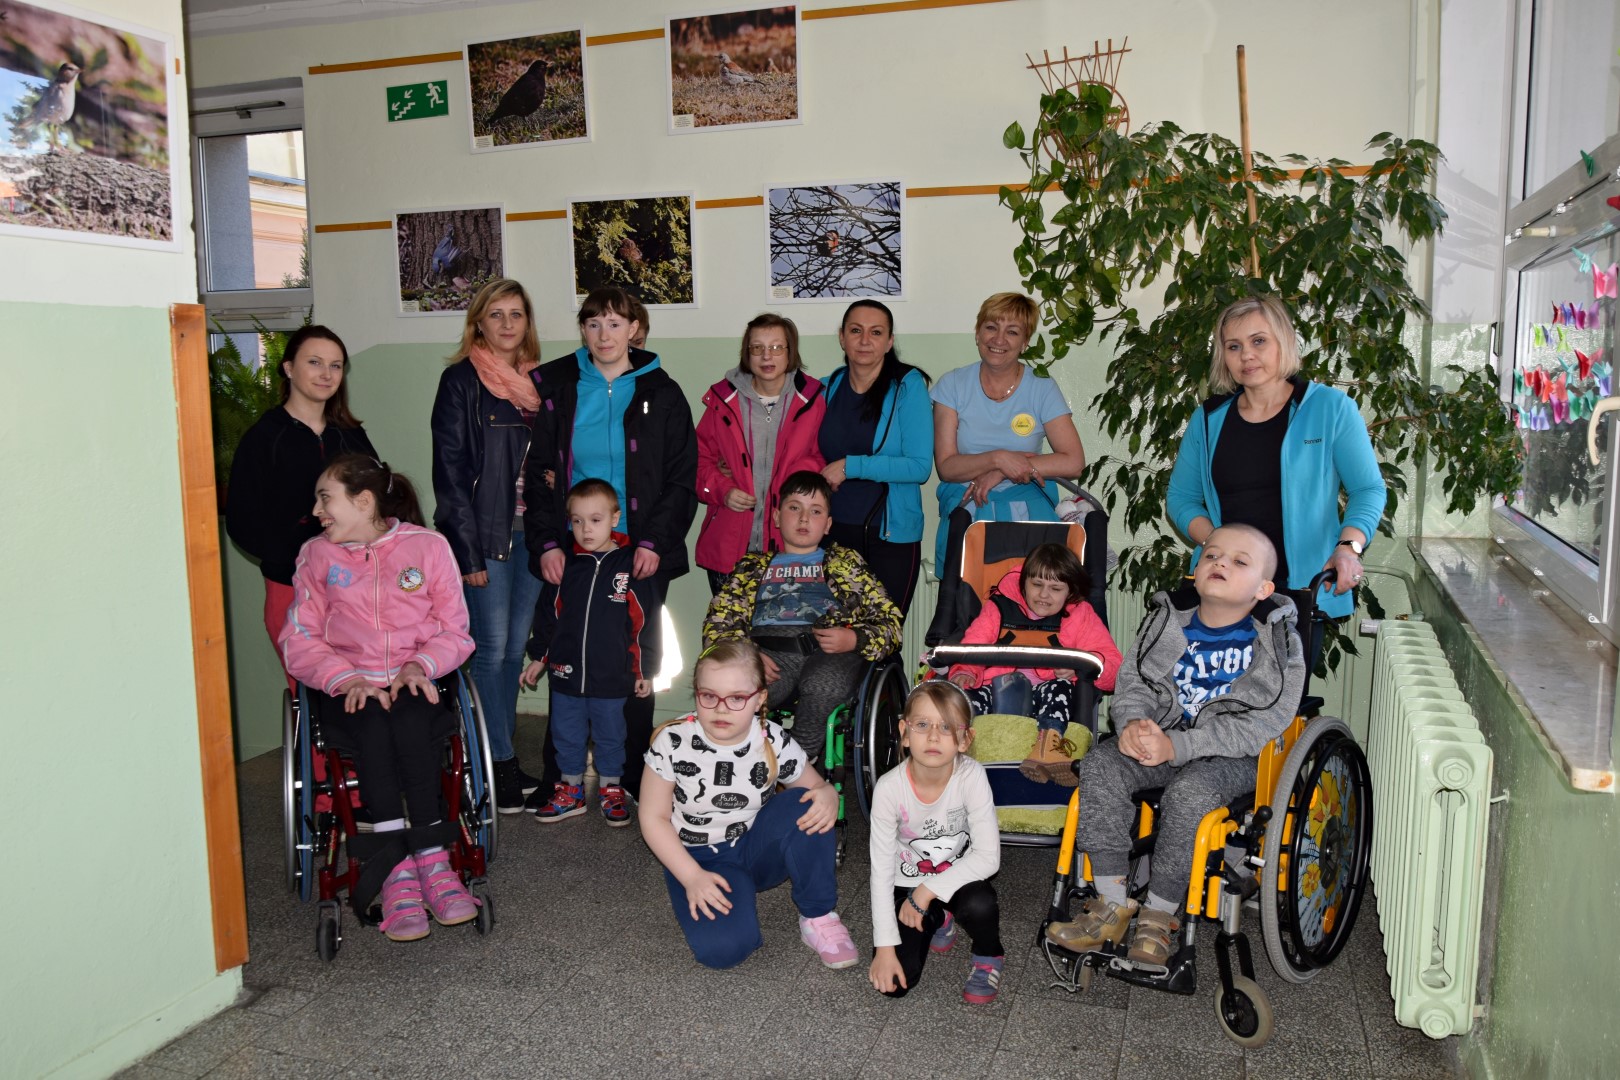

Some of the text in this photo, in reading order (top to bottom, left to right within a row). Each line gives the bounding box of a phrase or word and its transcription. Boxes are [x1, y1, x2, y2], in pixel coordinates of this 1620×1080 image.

[327, 564, 352, 588] 83
[719, 793, 738, 802] Paris
[679, 831, 707, 842] BONJOUR
